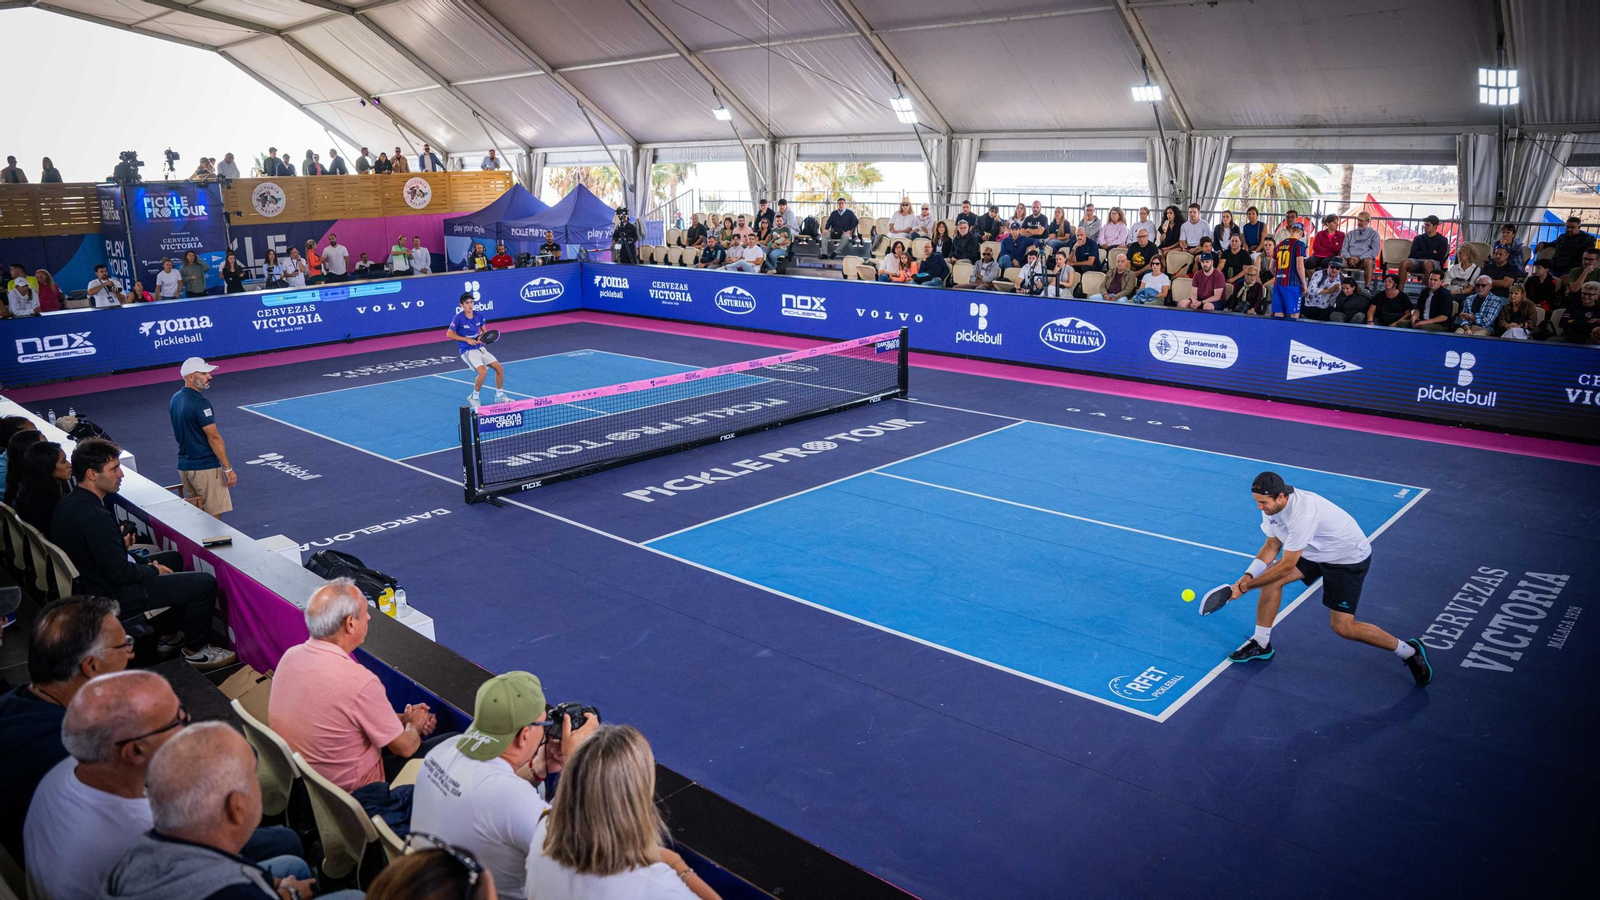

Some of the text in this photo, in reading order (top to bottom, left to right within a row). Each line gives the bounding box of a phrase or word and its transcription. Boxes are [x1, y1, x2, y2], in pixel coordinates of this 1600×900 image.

[143, 196, 188, 208] PICKLE
[588, 229, 603, 238] play
[106, 240, 124, 258] PLAY
[160, 242, 203, 250] VICTORIA
[1276, 250, 1290, 270] 10
[109, 260, 129, 276] YOUR
[524, 288, 560, 298] ASTURIANA
[652, 281, 688, 291] CERVEZAS
[600, 290, 623, 298] pickleball
[649, 289, 692, 302] VICTORIA
[719, 295, 752, 308] ASTURIANA
[257, 304, 316, 317] CERVEZAS
[356, 300, 425, 314] VOLVO
[456, 300, 493, 315] pebull
[252, 313, 322, 330] VICTORIA
[856, 308, 923, 323] VOLVO
[154, 333, 203, 348] pickleball
[956, 329, 1002, 346] picklebull
[1044, 328, 1100, 347] ASTURIANA
[1184, 339, 1218, 349] Ajuntament
[1184, 347, 1226, 359] Barcelona
[1292, 354, 1346, 370] El Corte Inglés
[1417, 384, 1497, 407] picklebull
[480, 413, 522, 424] BARCELONA
[496, 420, 514, 428] OPEN
[265, 459, 322, 481] picklebull
[1420, 565, 1508, 650] CERVEZAS
[1460, 571, 1570, 673] VICTORIA
[1547, 606, 1583, 649] MÁLAGA 1928
[1125, 666, 1167, 693] RFET
[1151, 675, 1184, 697] PICKLEBALL
